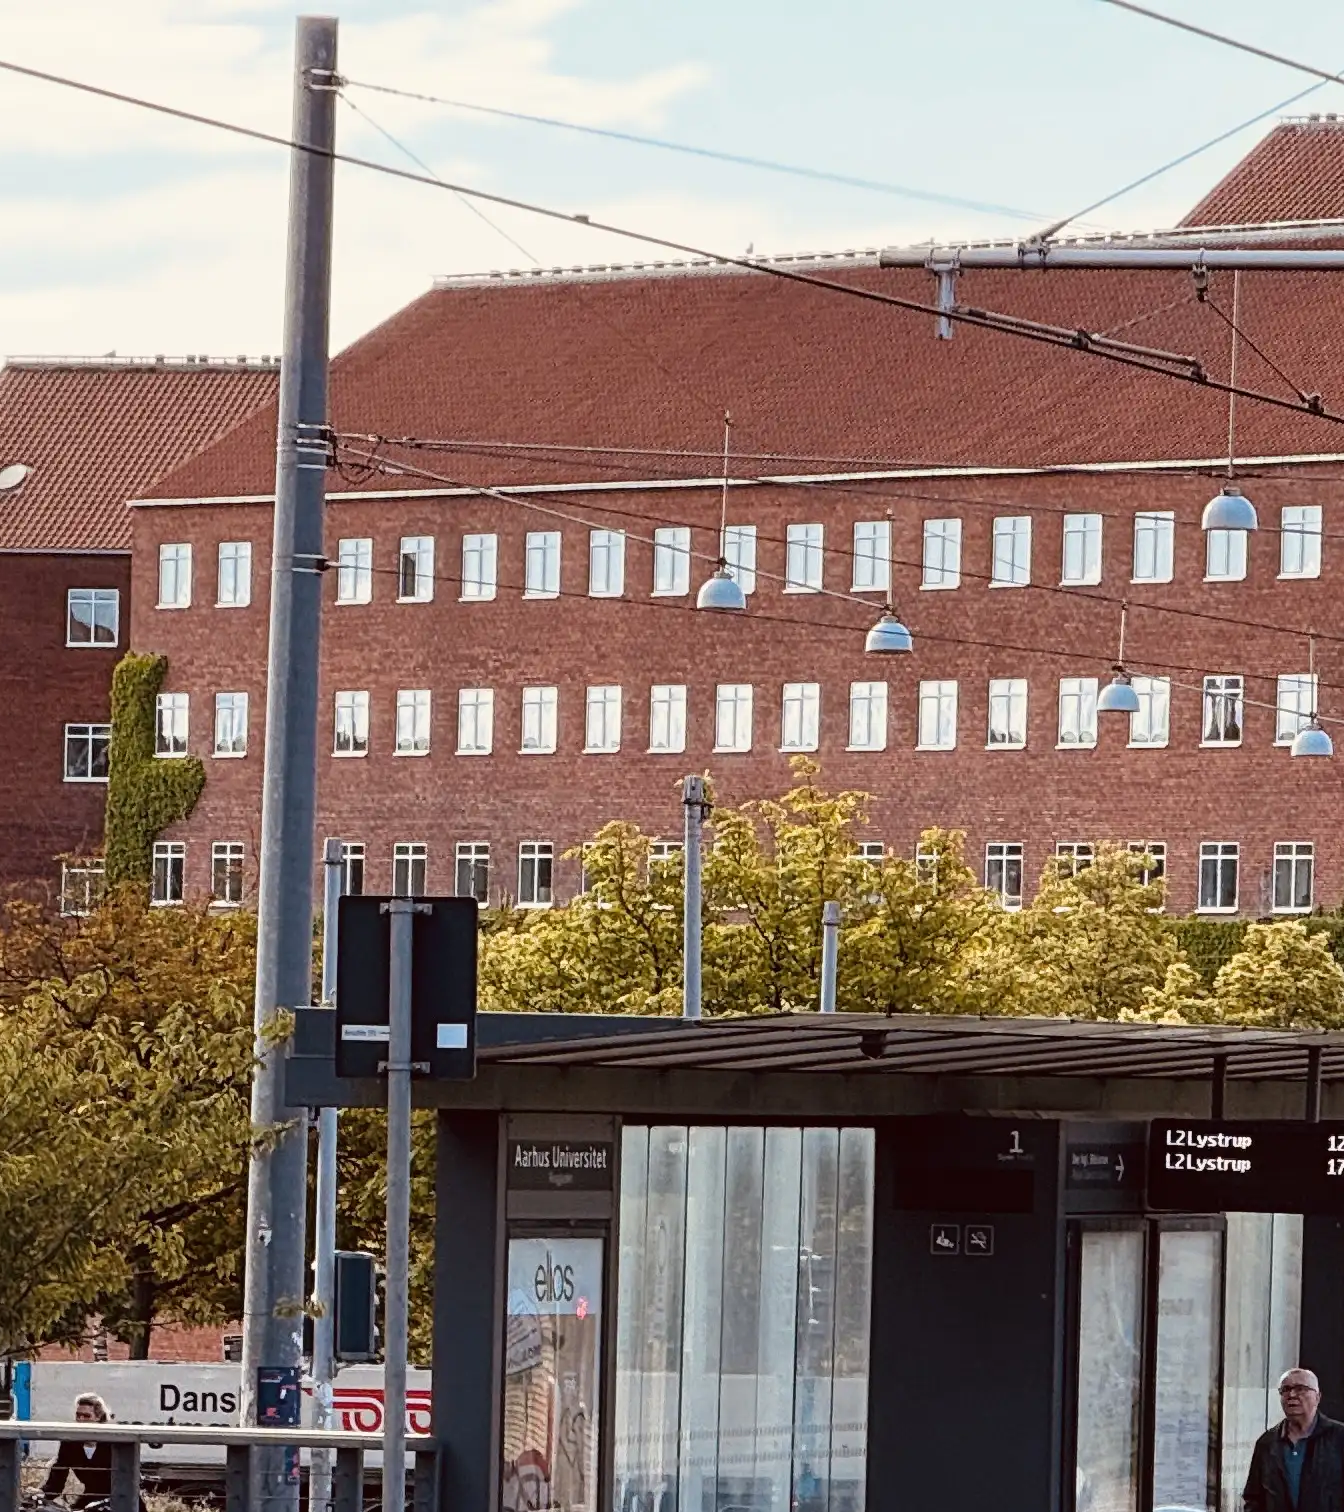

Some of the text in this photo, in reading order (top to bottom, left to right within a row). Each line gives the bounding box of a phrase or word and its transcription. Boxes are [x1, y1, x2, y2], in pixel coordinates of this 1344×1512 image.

[1009, 1130, 1024, 1153] 1
[1166, 1129, 1186, 1146] L2
[1187, 1130, 1253, 1149] Lystrup
[514, 1144, 607, 1168] Aarhus Universitet
[1165, 1152, 1185, 1170] L2
[1186, 1153, 1252, 1173] Lystrup
[534, 1250, 574, 1302] ellos
[160, 1384, 241, 1413] Dans
